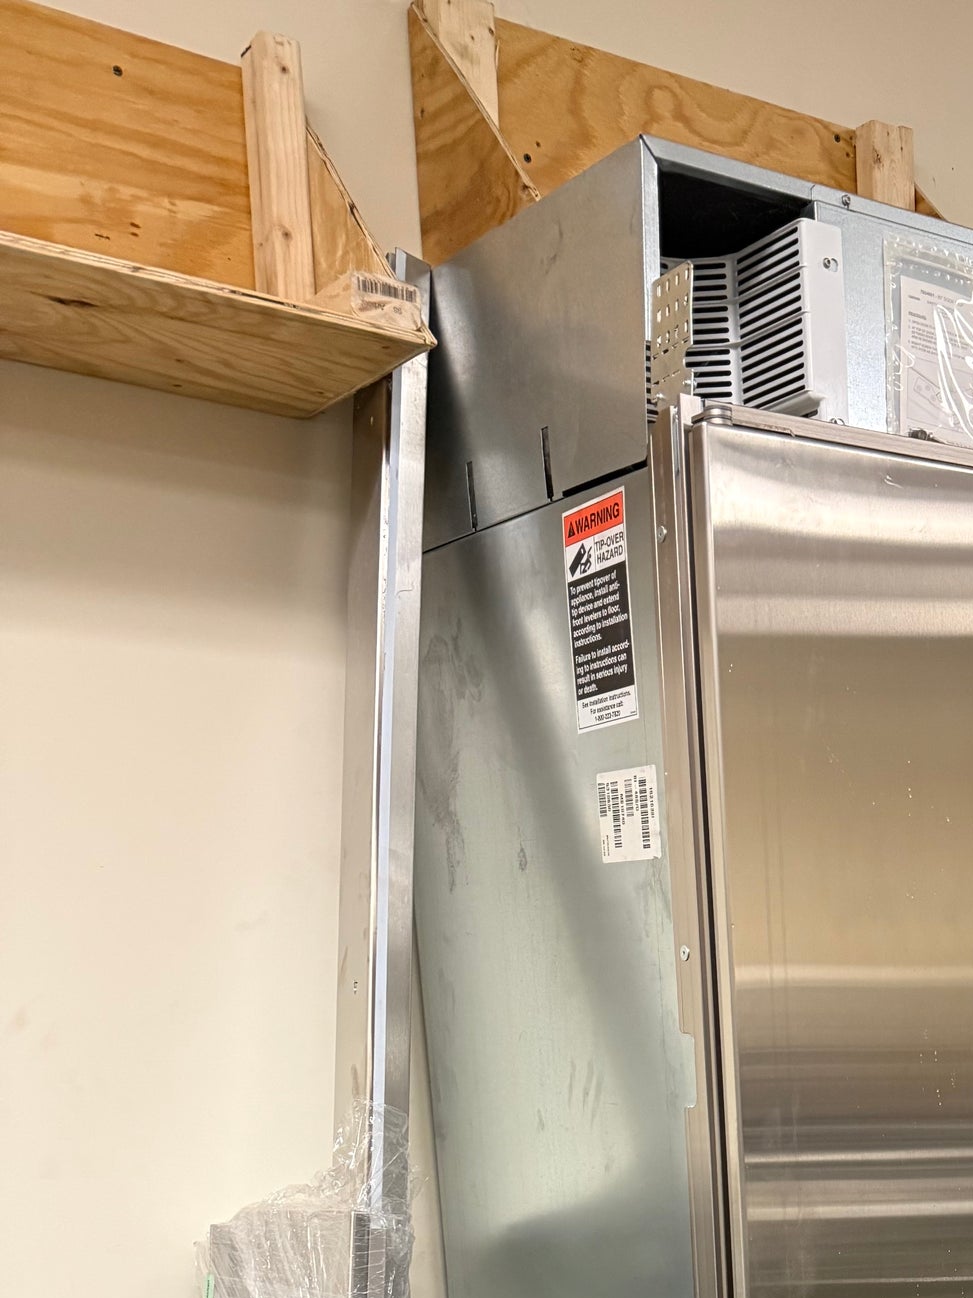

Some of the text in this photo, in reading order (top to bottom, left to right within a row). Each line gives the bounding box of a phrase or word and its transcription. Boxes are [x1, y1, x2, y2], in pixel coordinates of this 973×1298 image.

[575, 502, 620, 535] WARNING
[594, 531, 624, 551] TIP-OVER
[596, 545, 623, 564] HAZARD
[570, 586, 576, 595] To
[576, 580, 594, 595] prevent
[594, 574, 611, 587] tipover
[571, 592, 594, 607] appliance,
[594, 585, 608, 597] install
[578, 603, 593, 614] device
[594, 598, 603, 608] and
[603, 591, 620, 605] extend
[572, 616, 584, 627] front
[583, 611, 602, 623] levelers
[602, 608, 607, 616] to
[573, 613, 628, 638] according to installation
[574, 633, 602, 648] instructions.
[575, 653, 591, 664] Failure
[591, 651, 596, 659] to
[597, 645, 611, 657] install
[576, 653, 627, 676] ing to instructions can
[577, 664, 628, 685] result in serious injury
